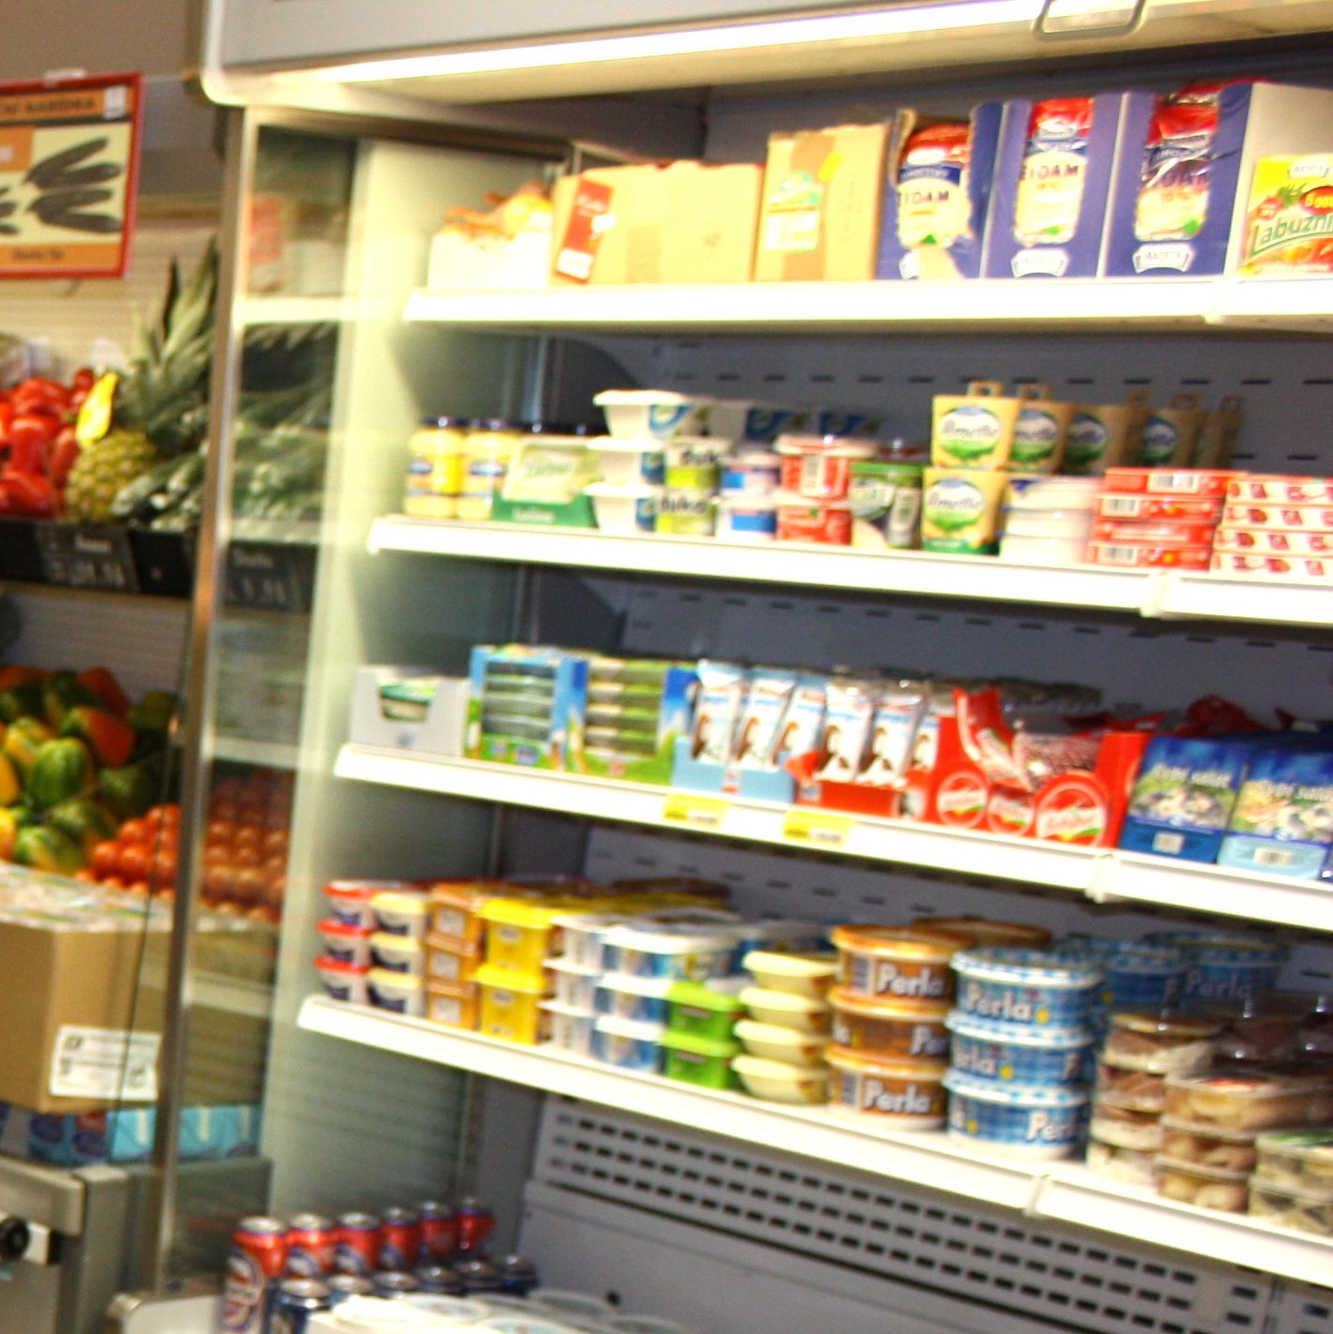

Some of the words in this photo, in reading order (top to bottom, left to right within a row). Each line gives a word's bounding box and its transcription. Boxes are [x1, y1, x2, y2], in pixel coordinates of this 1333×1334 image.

[875, 962, 947, 998] Perla
[967, 981, 1034, 1023] Perla
[862, 1079, 933, 1115] Perla
